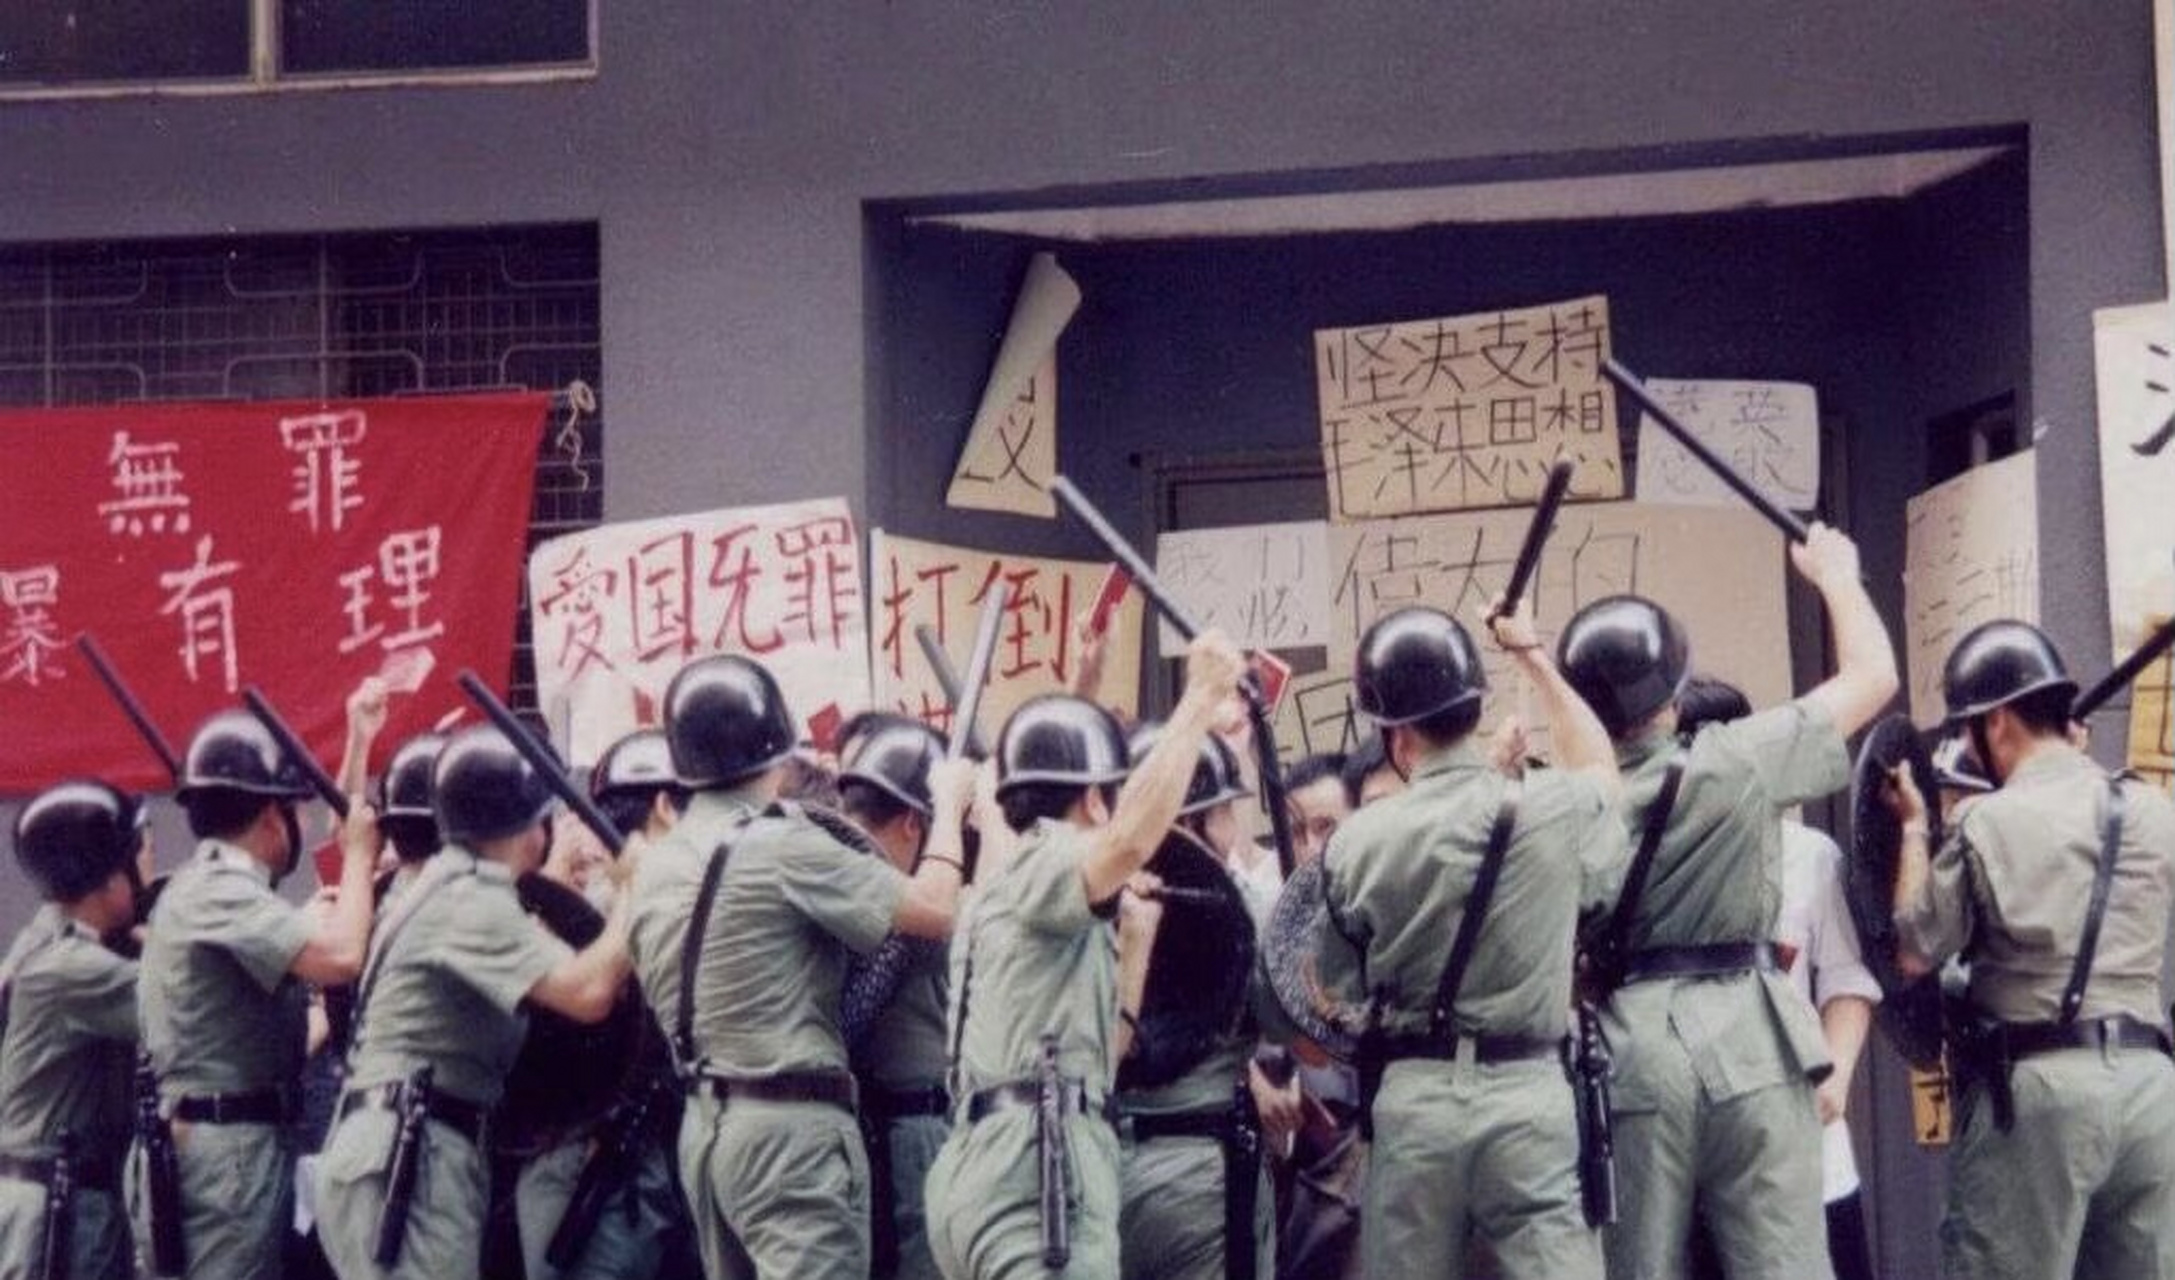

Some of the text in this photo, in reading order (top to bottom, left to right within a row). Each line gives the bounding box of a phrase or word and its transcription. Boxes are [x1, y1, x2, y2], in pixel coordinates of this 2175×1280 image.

[98, 411, 366, 533] 無罪
[0, 525, 443, 693] 暴有理
[882, 556, 1074, 684] 打倒
